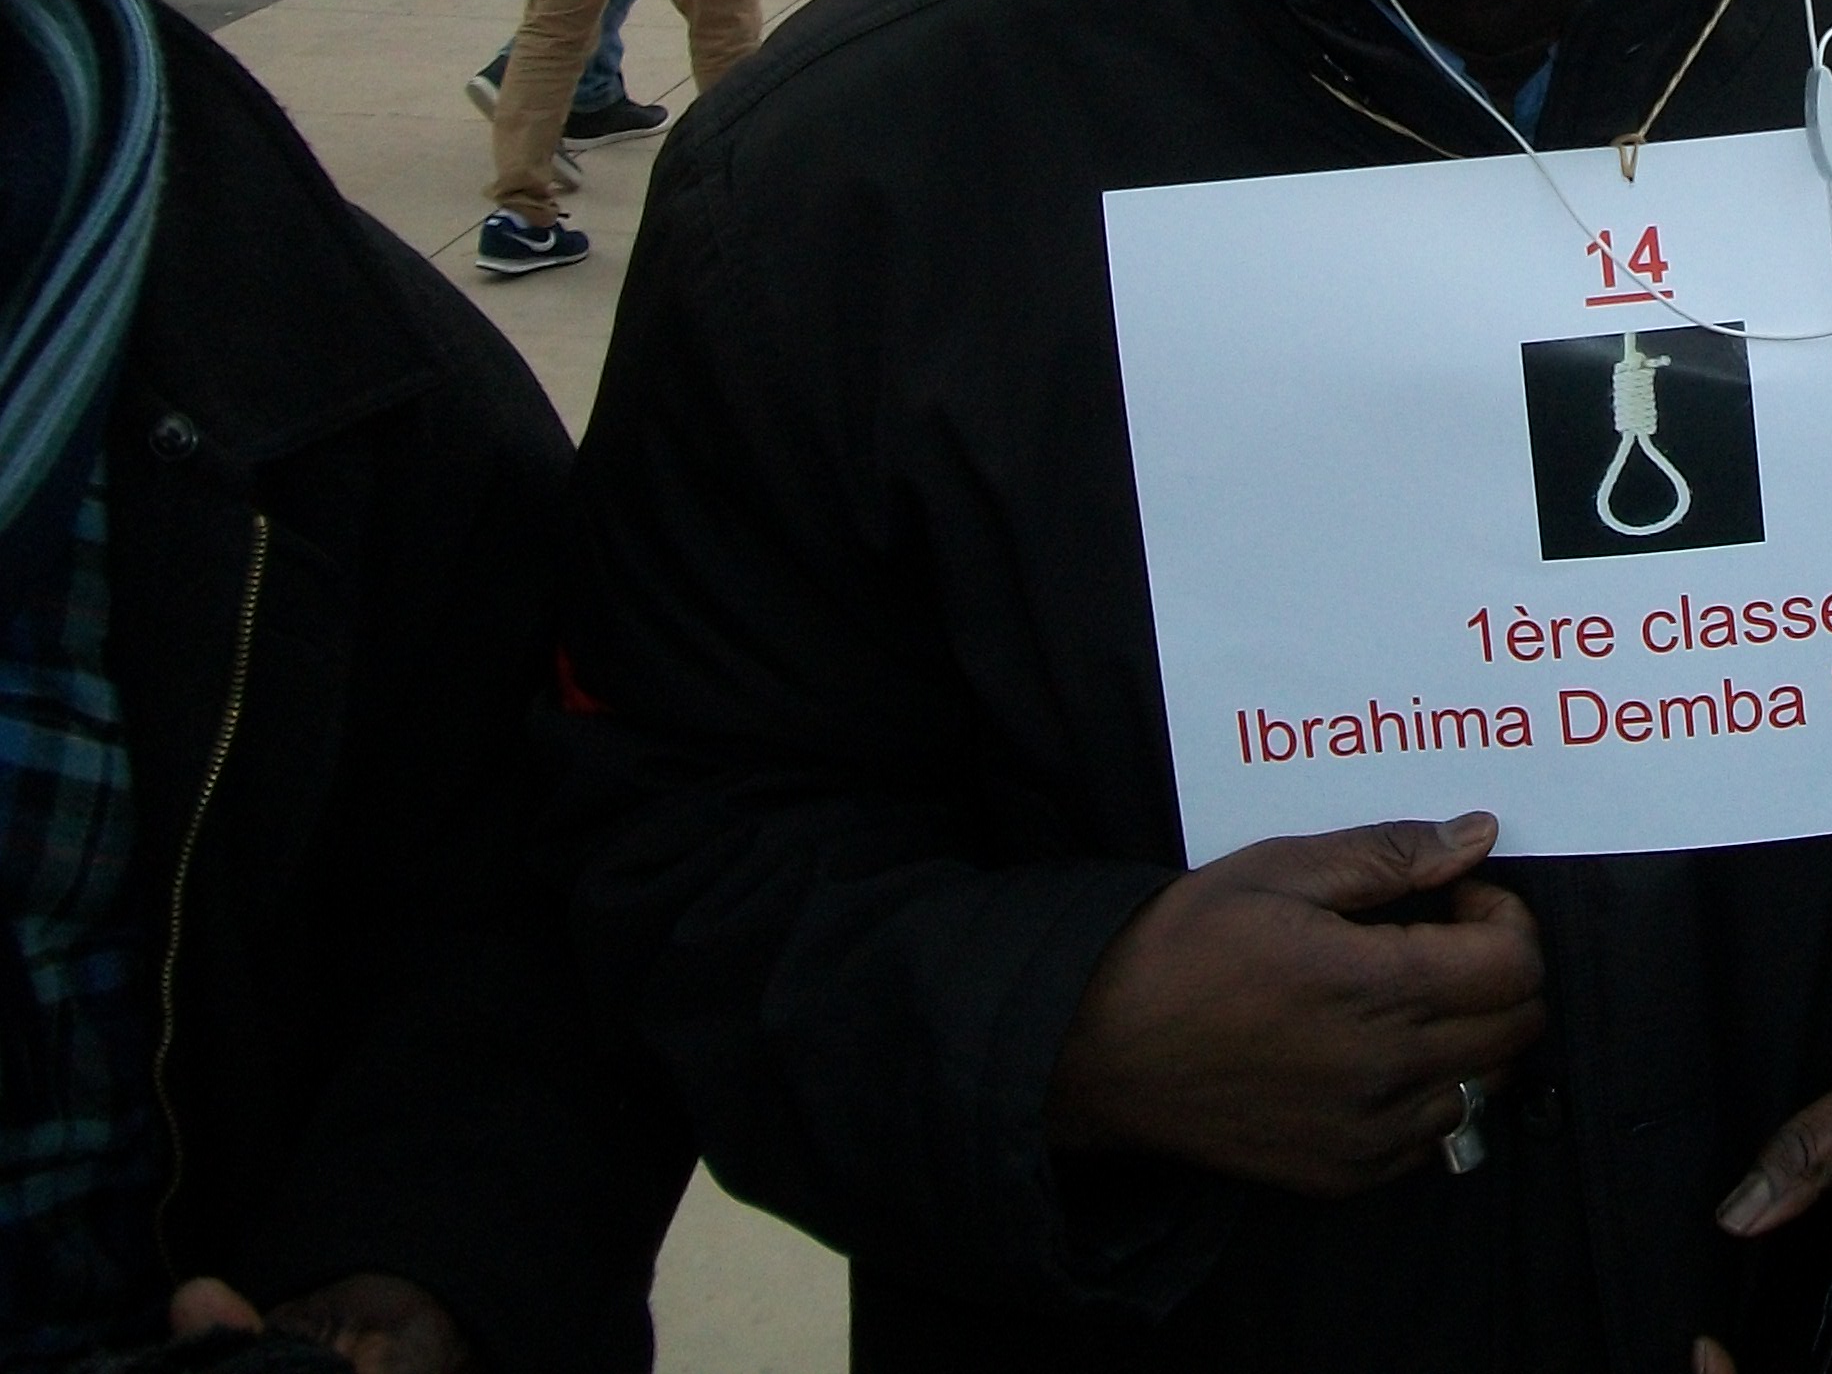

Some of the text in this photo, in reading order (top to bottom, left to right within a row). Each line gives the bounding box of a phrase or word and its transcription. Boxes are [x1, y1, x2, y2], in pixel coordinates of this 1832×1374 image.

[1586, 225, 1669, 290] 14
[1466, 605, 1615, 663] 1ère
[1236, 695, 1534, 764] Ibrahima
[1558, 679, 1807, 746] Demba
